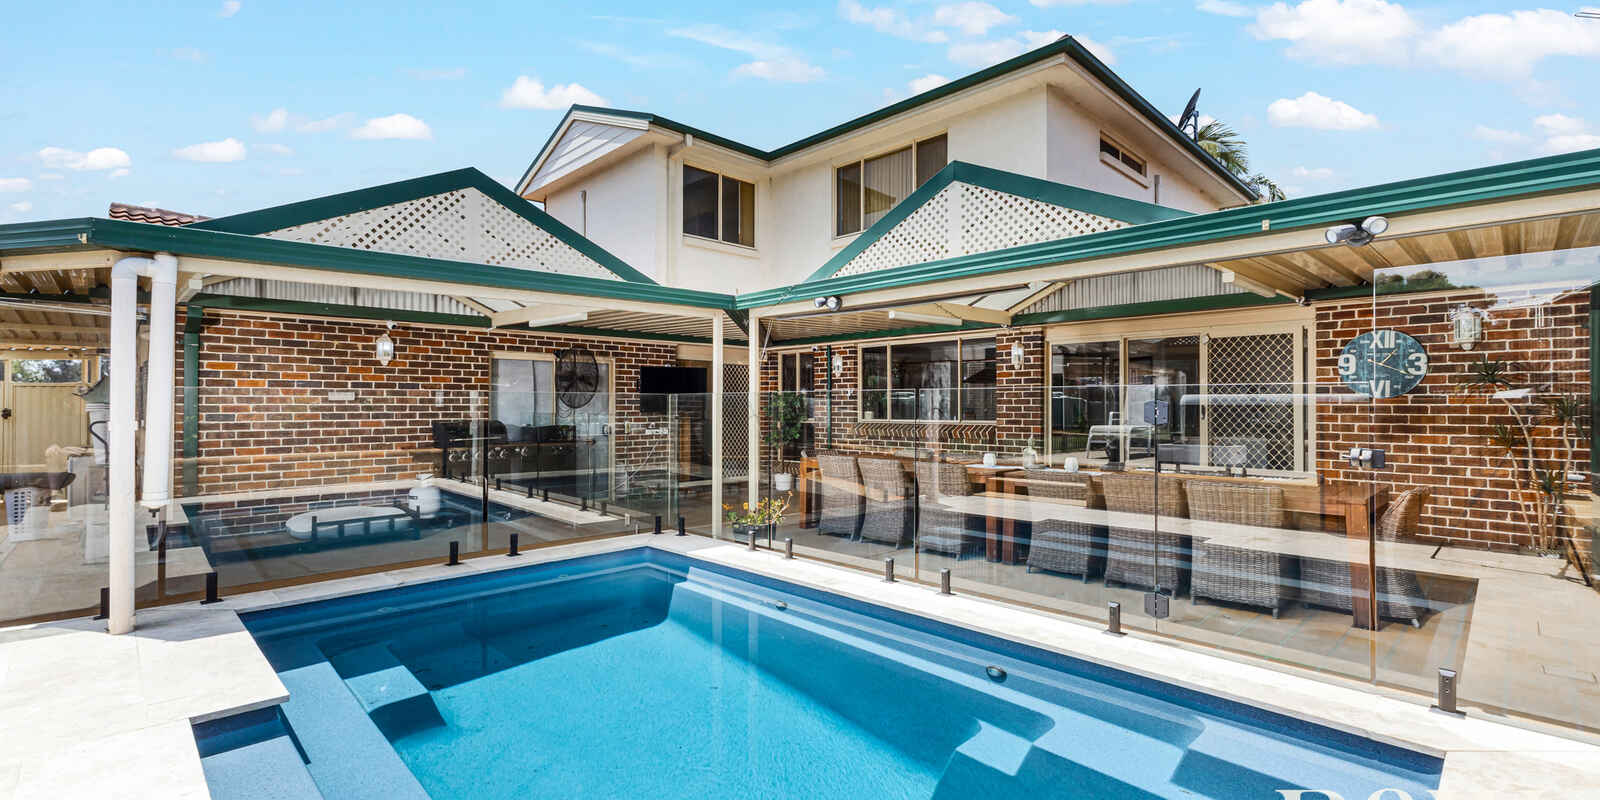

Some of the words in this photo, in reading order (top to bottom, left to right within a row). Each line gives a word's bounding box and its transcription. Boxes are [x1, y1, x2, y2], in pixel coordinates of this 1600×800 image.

[1369, 330, 1395, 349] XII
[1338, 354, 1356, 375] 9
[1406, 353, 1428, 375] 3
[1369, 380, 1391, 398] VI
